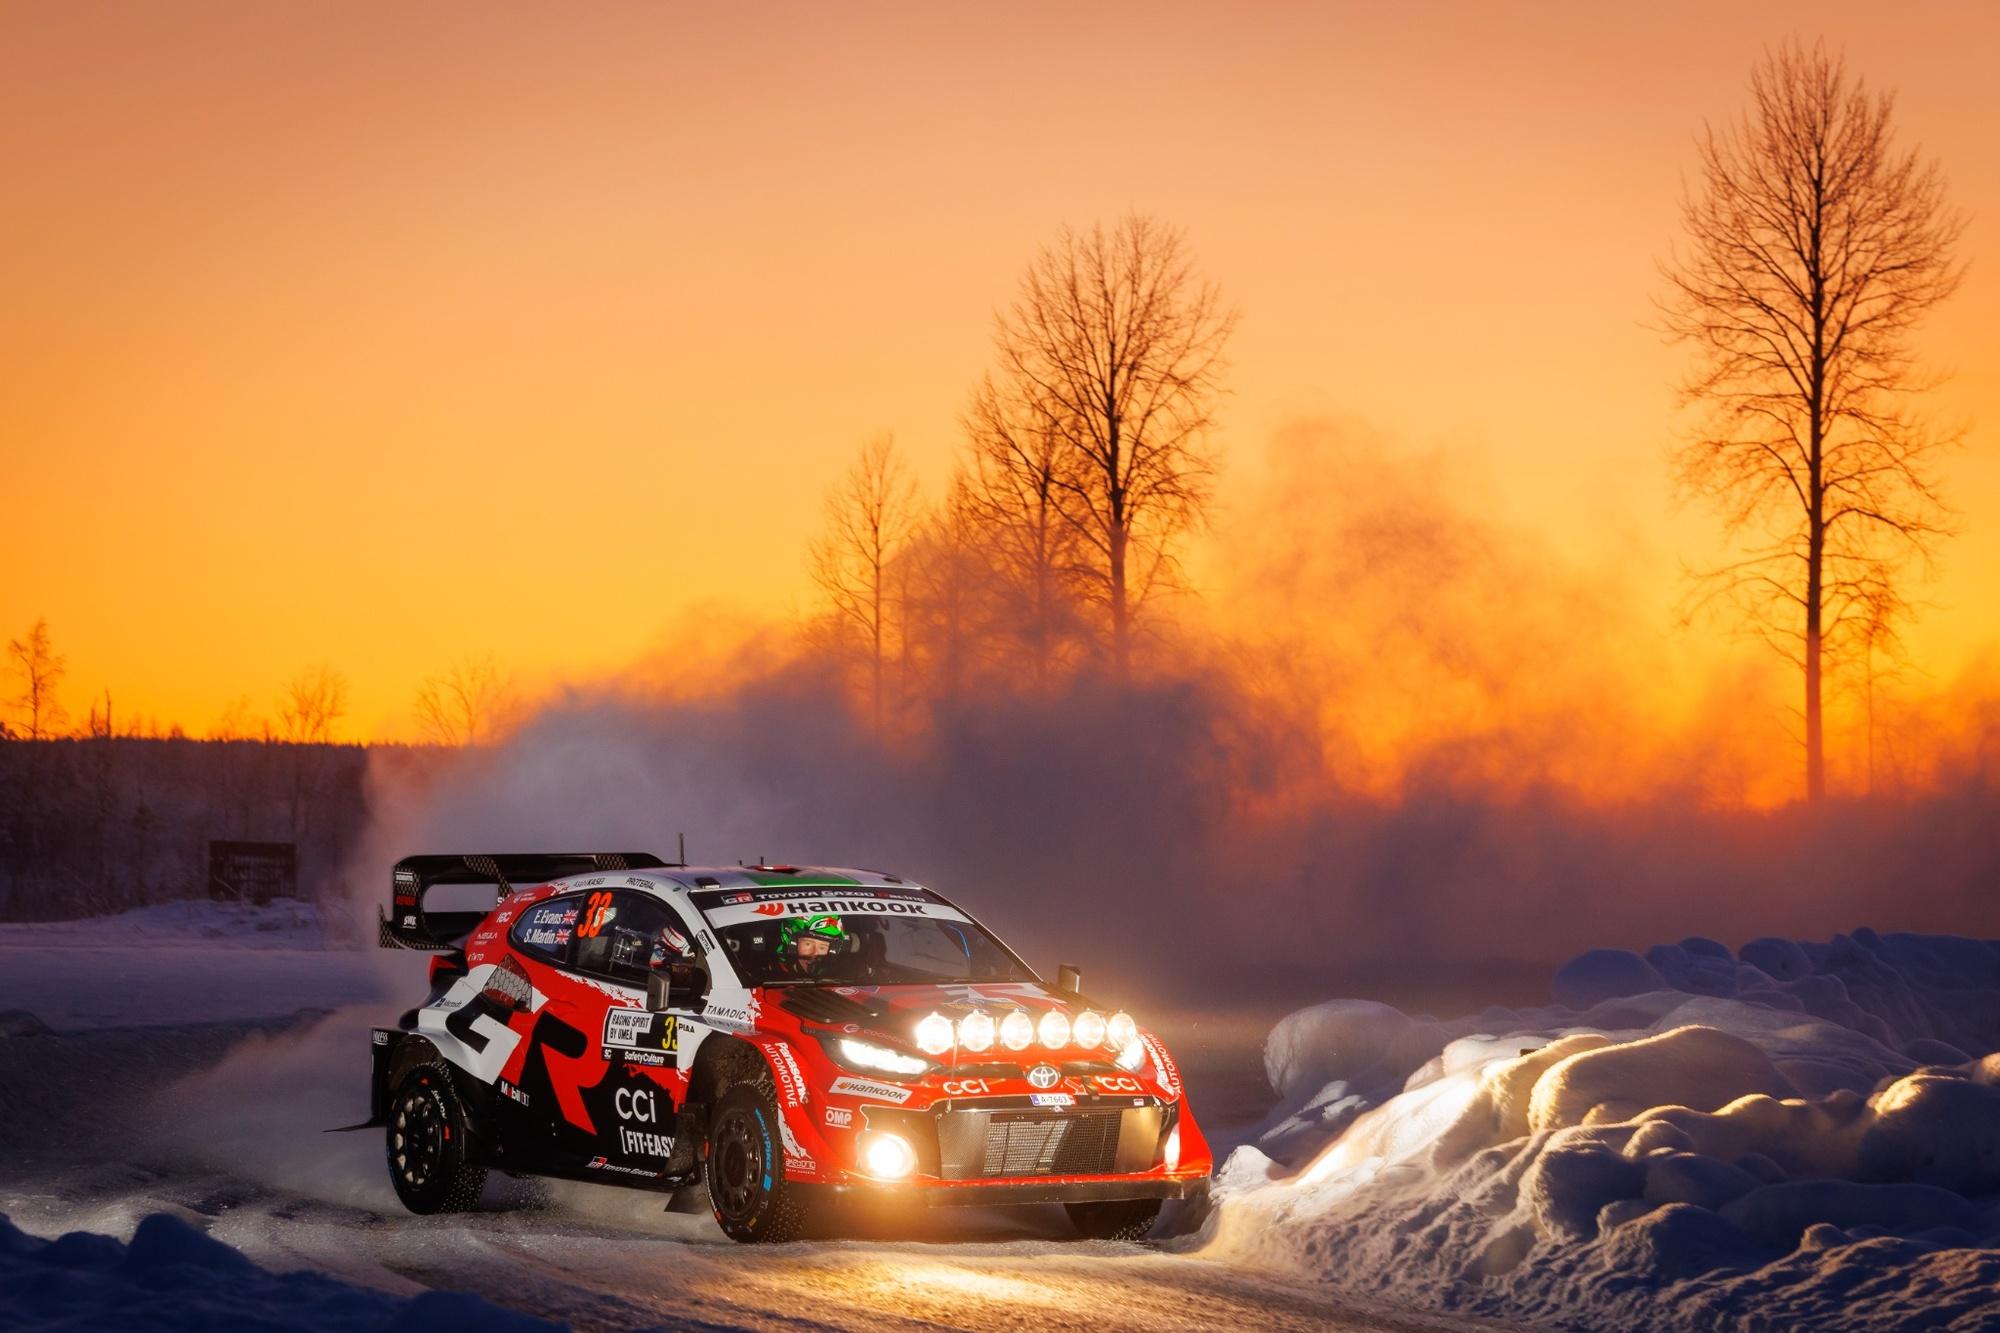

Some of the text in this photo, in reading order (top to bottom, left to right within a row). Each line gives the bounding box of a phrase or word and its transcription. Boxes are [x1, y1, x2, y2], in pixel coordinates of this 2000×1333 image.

[625, 877, 657, 890] PROTERIAL
[757, 891, 819, 900] TOYOTA
[821, 890, 875, 899] GAZOO
[534, 910, 564, 925] E.Evans
[577, 891, 613, 938] 33
[524, 929, 556, 945] S.Martin
[707, 1005, 747, 1020] TAMADIC
[611, 1014, 650, 1028] RACING SPIRIT
[610, 1028, 617, 1039] BY
[678, 1023, 695, 1034] PIAA
[604, 1049, 612, 1059] SC
[624, 1050, 665, 1064] SafetyCulture
[762, 1043, 798, 1108] AUTOMOTIVE
[826, 1109, 852, 1125] OMP
